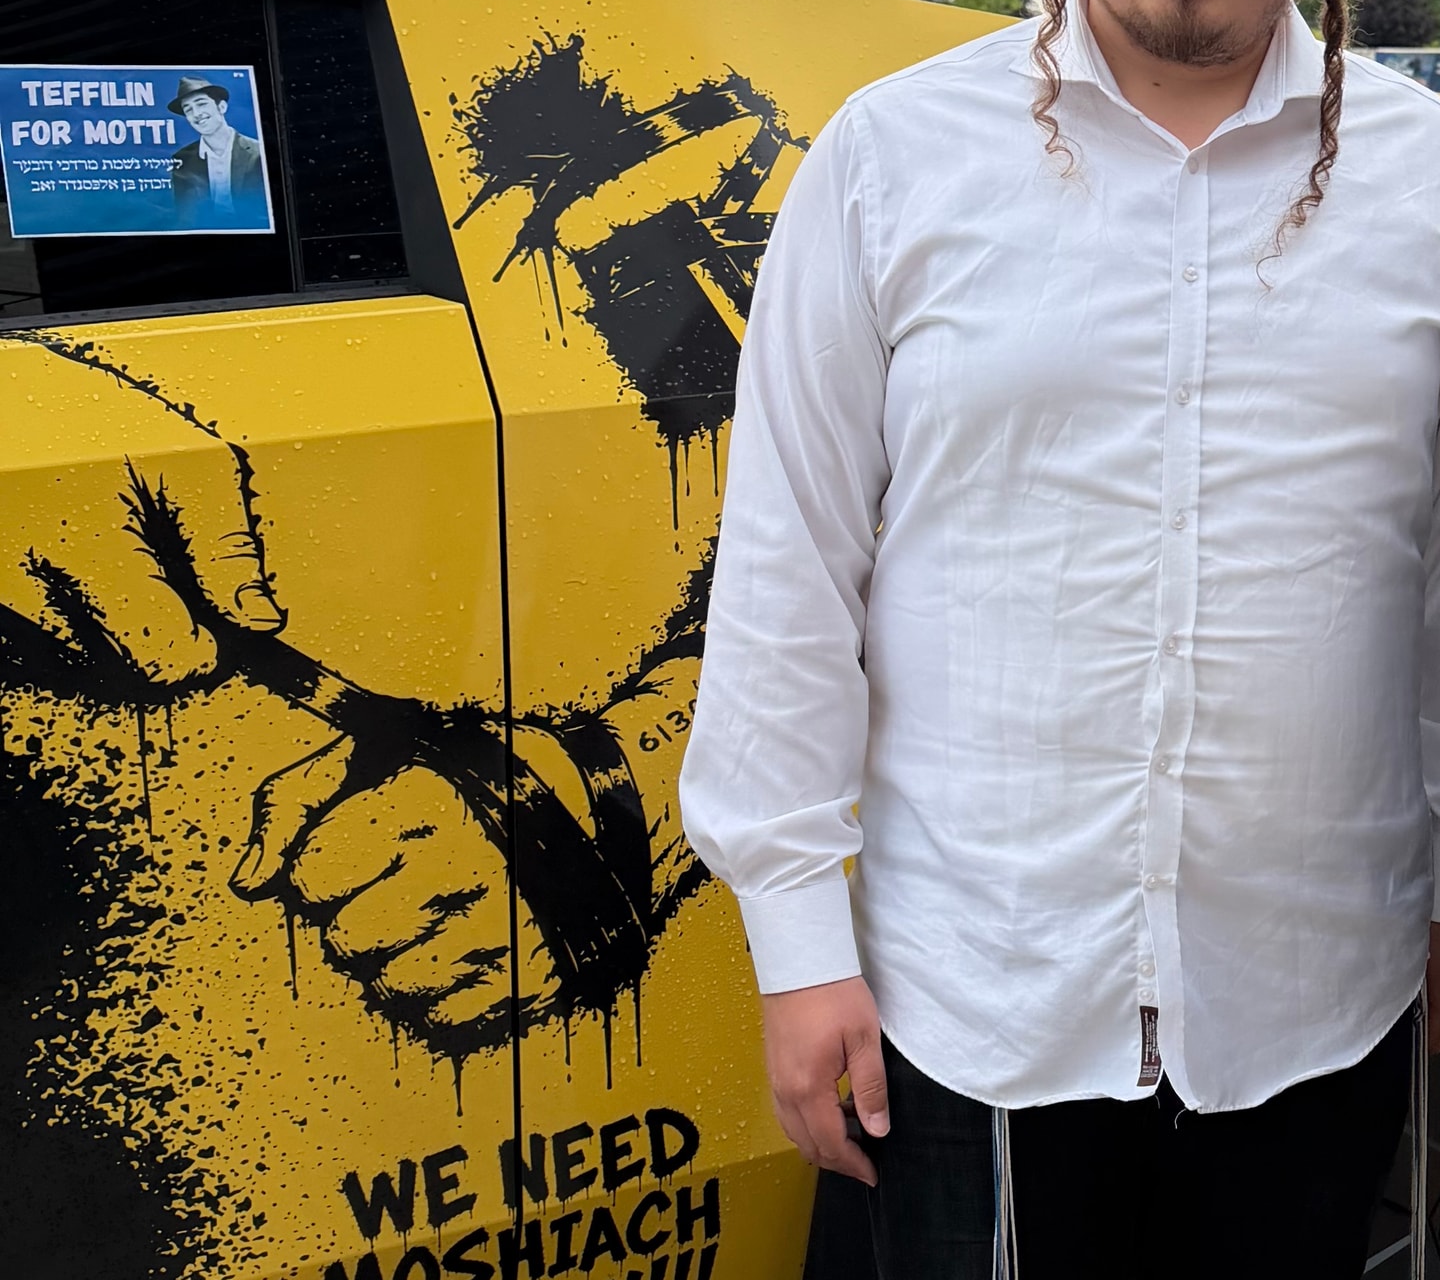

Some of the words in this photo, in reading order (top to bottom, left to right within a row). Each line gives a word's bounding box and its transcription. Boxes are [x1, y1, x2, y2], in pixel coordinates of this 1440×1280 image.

[21, 81, 154, 106] TEFFILIN
[12, 120, 72, 146] FOR
[84, 119, 176, 145] MOTTI
[12, 159, 53, 175] דובער
[56, 159, 99, 172] מרדכי
[144, 158, 184, 172] לעילוי
[30, 179, 57, 193] זאב
[138, 177, 172, 193] הכהן
[338, 1144, 479, 1246] WE
[498, 1107, 701, 1213] NEED
